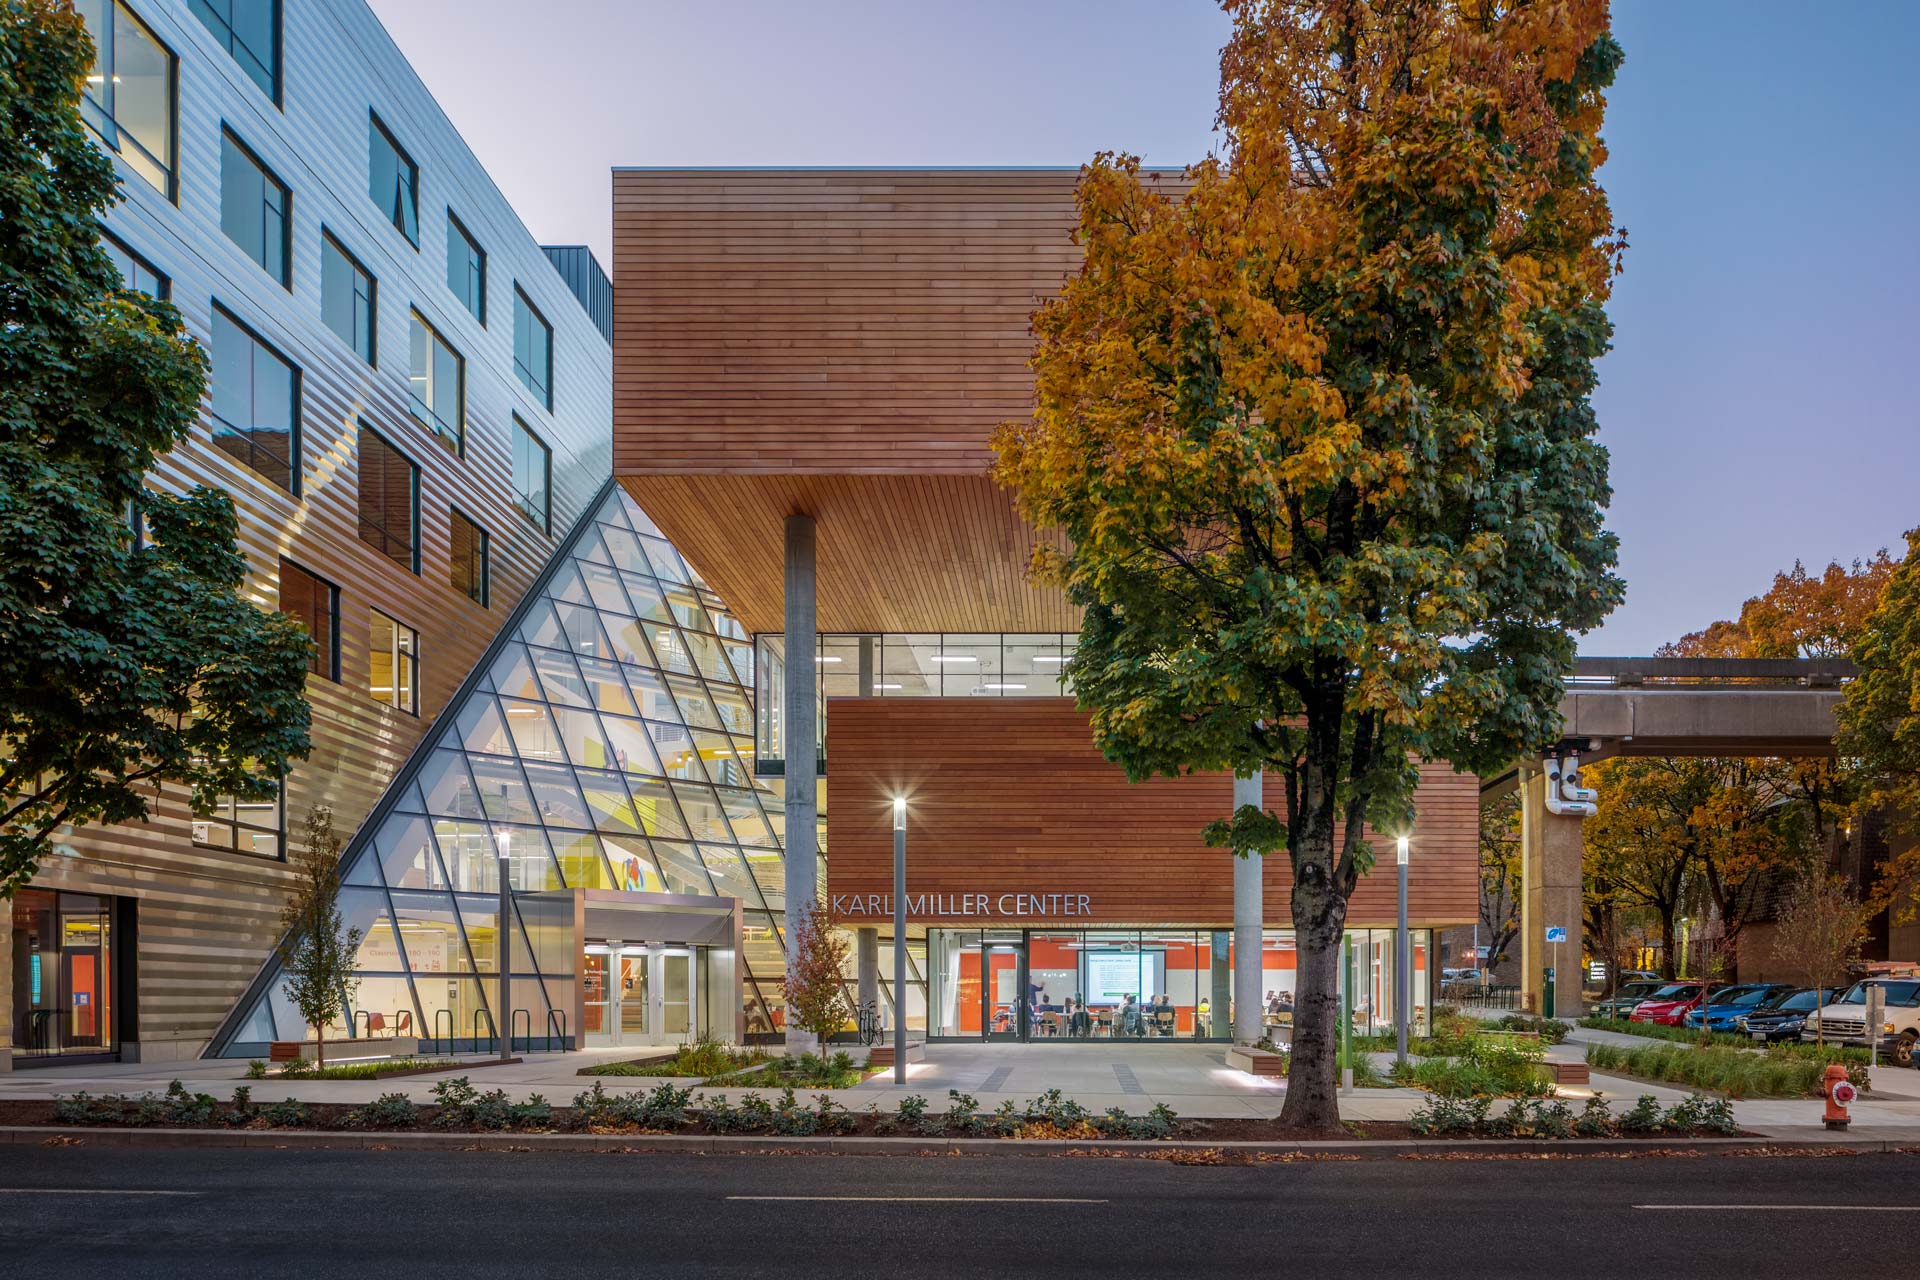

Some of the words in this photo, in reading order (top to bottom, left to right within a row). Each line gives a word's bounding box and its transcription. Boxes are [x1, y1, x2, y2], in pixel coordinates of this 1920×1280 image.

[833, 894, 895, 915] KARL
[904, 894, 990, 915] MILLER
[998, 894, 1091, 915] CENTER
